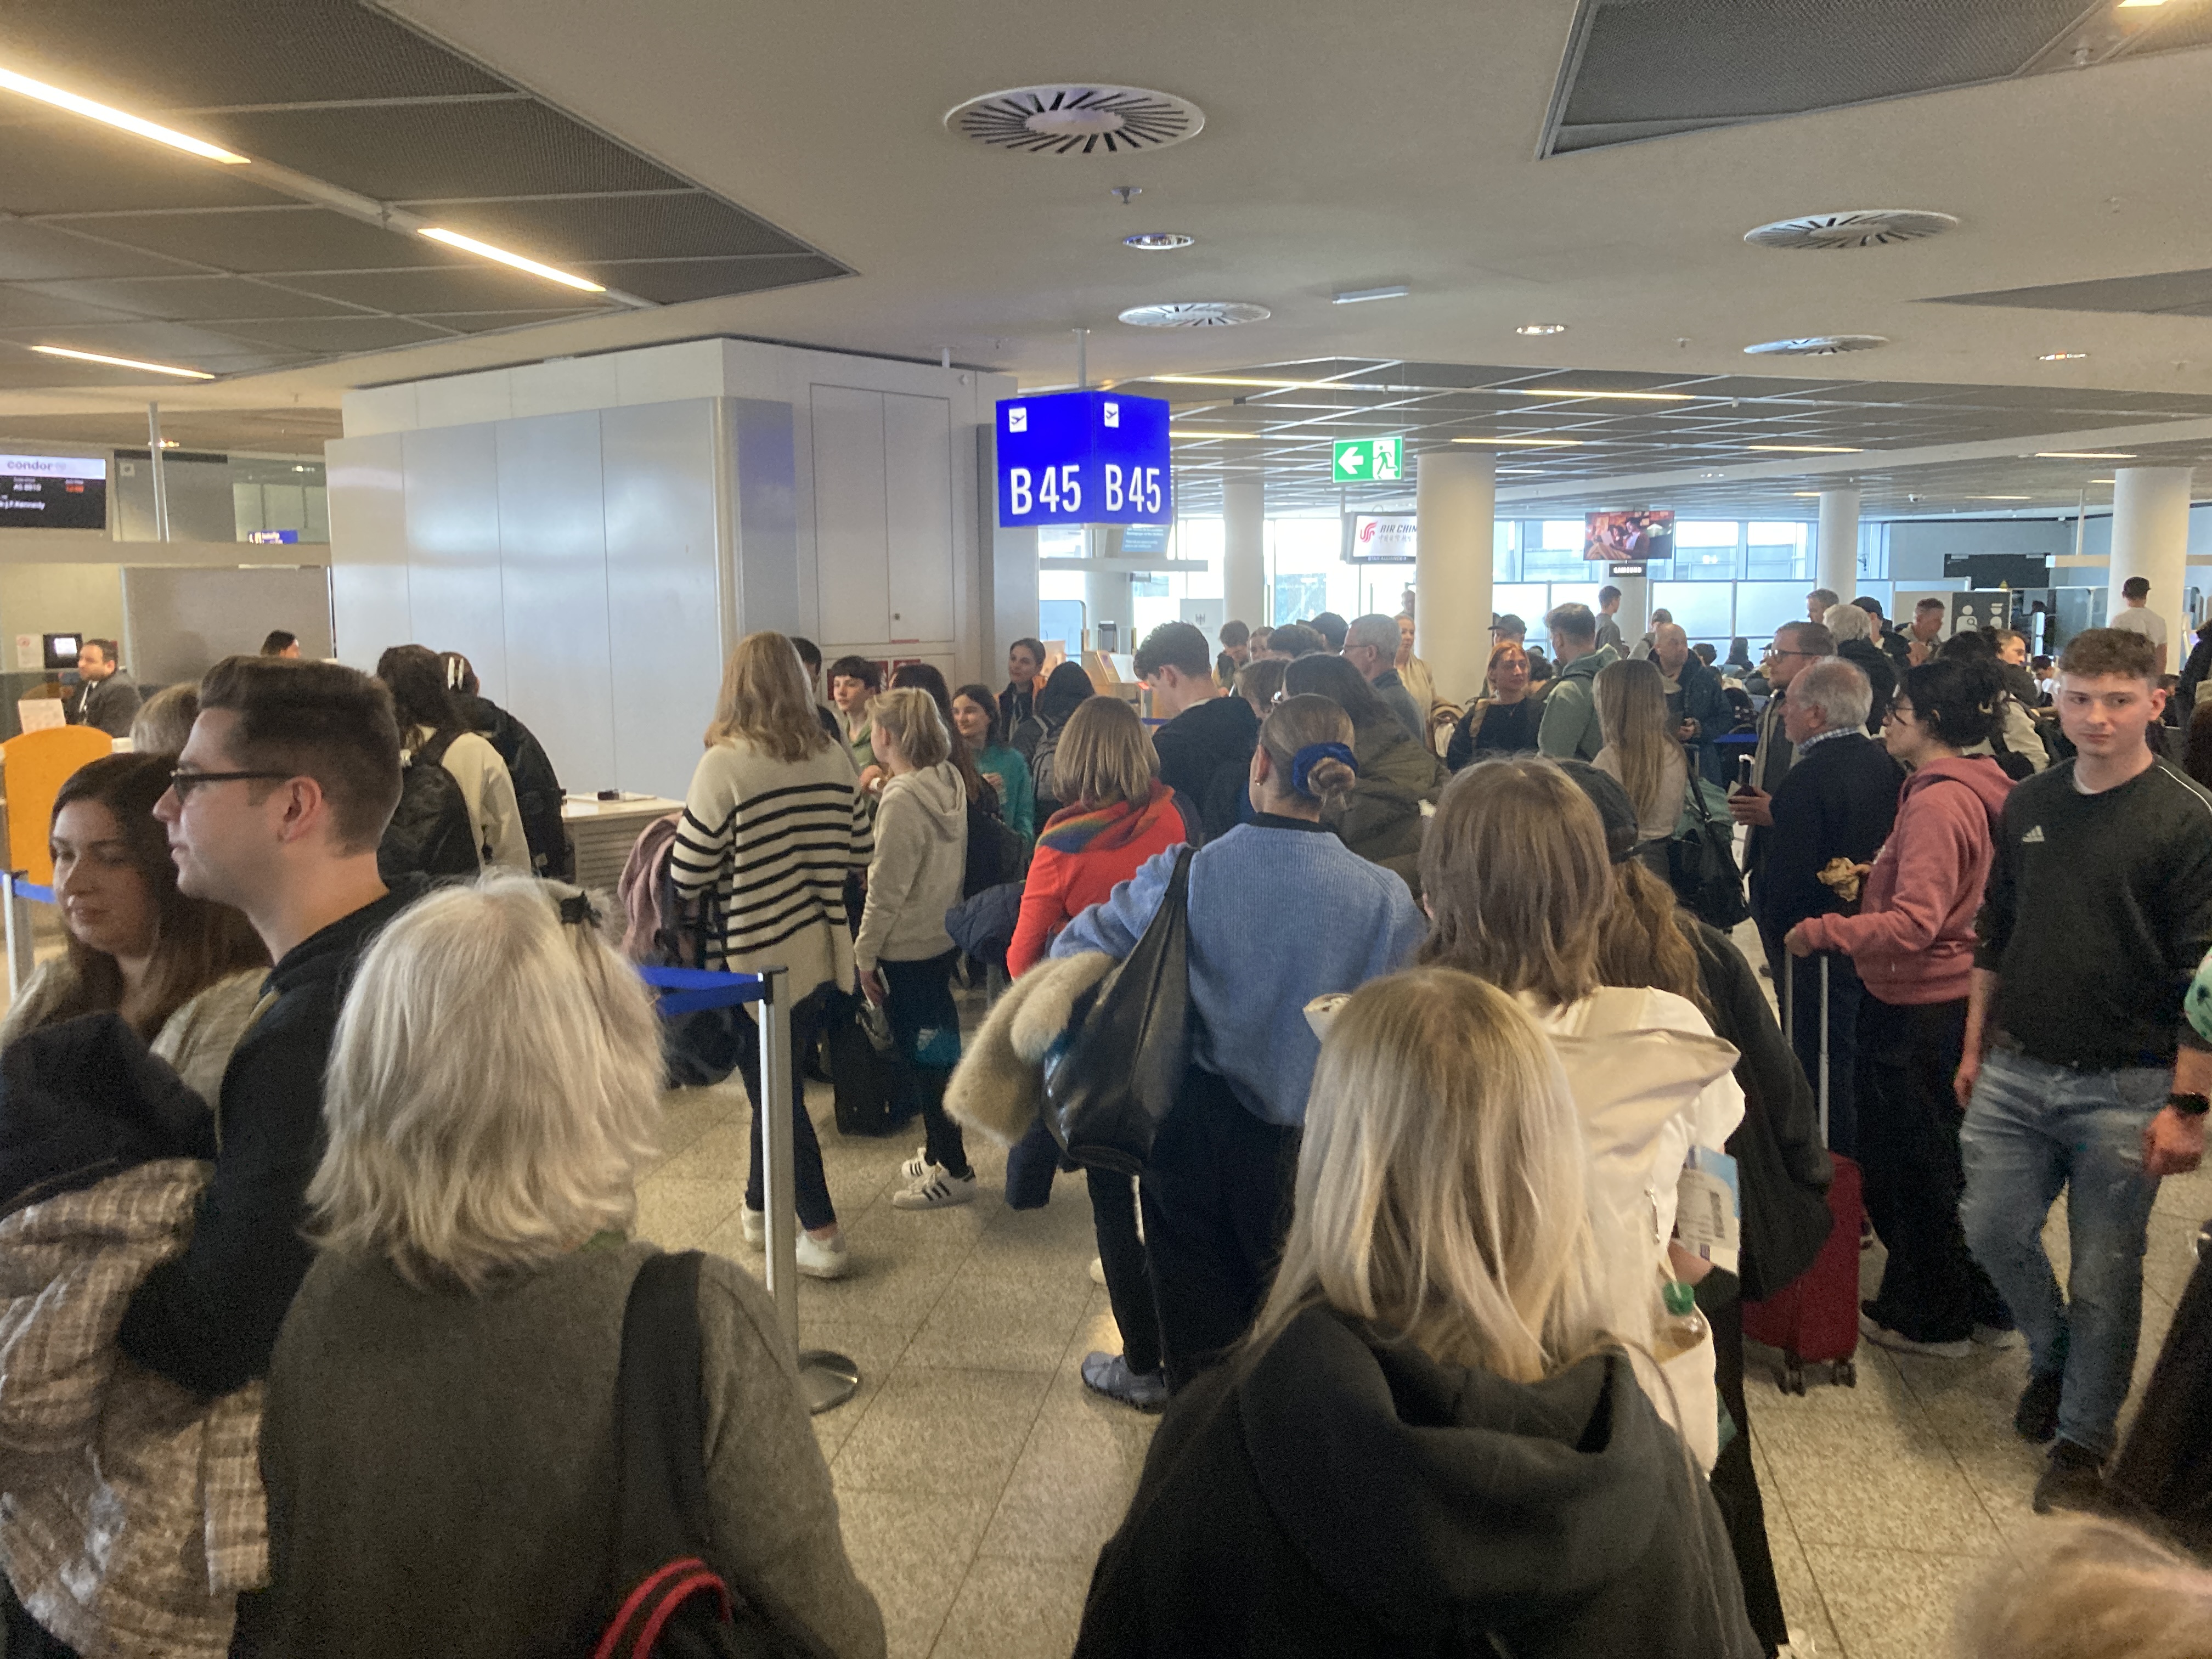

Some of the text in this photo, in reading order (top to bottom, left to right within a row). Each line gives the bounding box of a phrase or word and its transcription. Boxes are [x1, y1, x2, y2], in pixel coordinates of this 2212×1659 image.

[7, 461, 53, 471] condor
[1380, 524, 1417, 533] AIR CHIN
